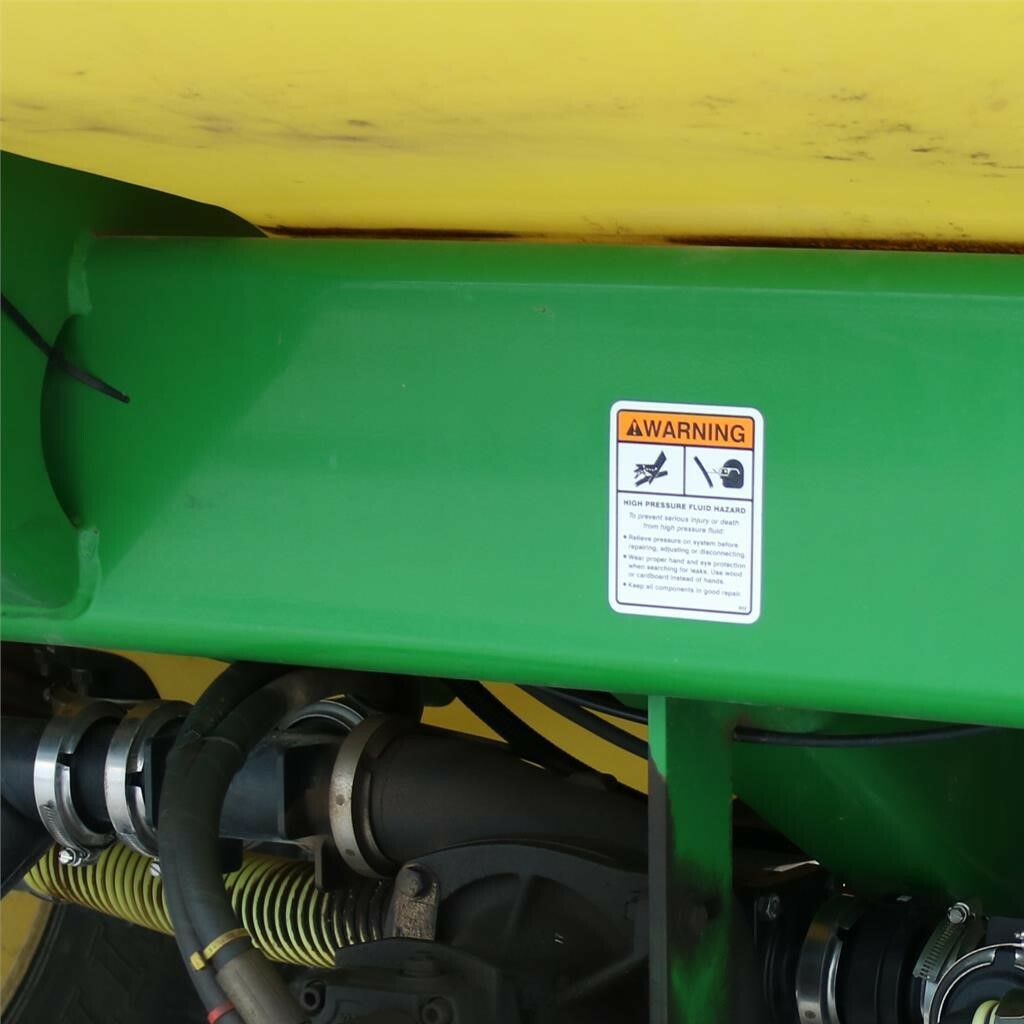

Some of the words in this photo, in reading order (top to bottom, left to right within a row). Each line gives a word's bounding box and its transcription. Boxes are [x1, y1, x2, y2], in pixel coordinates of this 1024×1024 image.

[643, 419, 745, 443] WARNING
[624, 499, 643, 507] HIGH
[645, 501, 687, 510] PRESSURE
[689, 503, 712, 512] FLUID
[714, 505, 747, 514] HAZARD
[691, 516, 709, 525] injury
[660, 524, 675, 532] high
[677, 526, 706, 534] pressure
[693, 540, 716, 548] system
[660, 546, 689, 555] adjusting
[647, 565, 677, 573] searching
[713, 561, 747, 569] protection
[636, 572, 669, 580] cardboard
[628, 582, 645, 590] Keep
[655, 585, 694, 593] components
